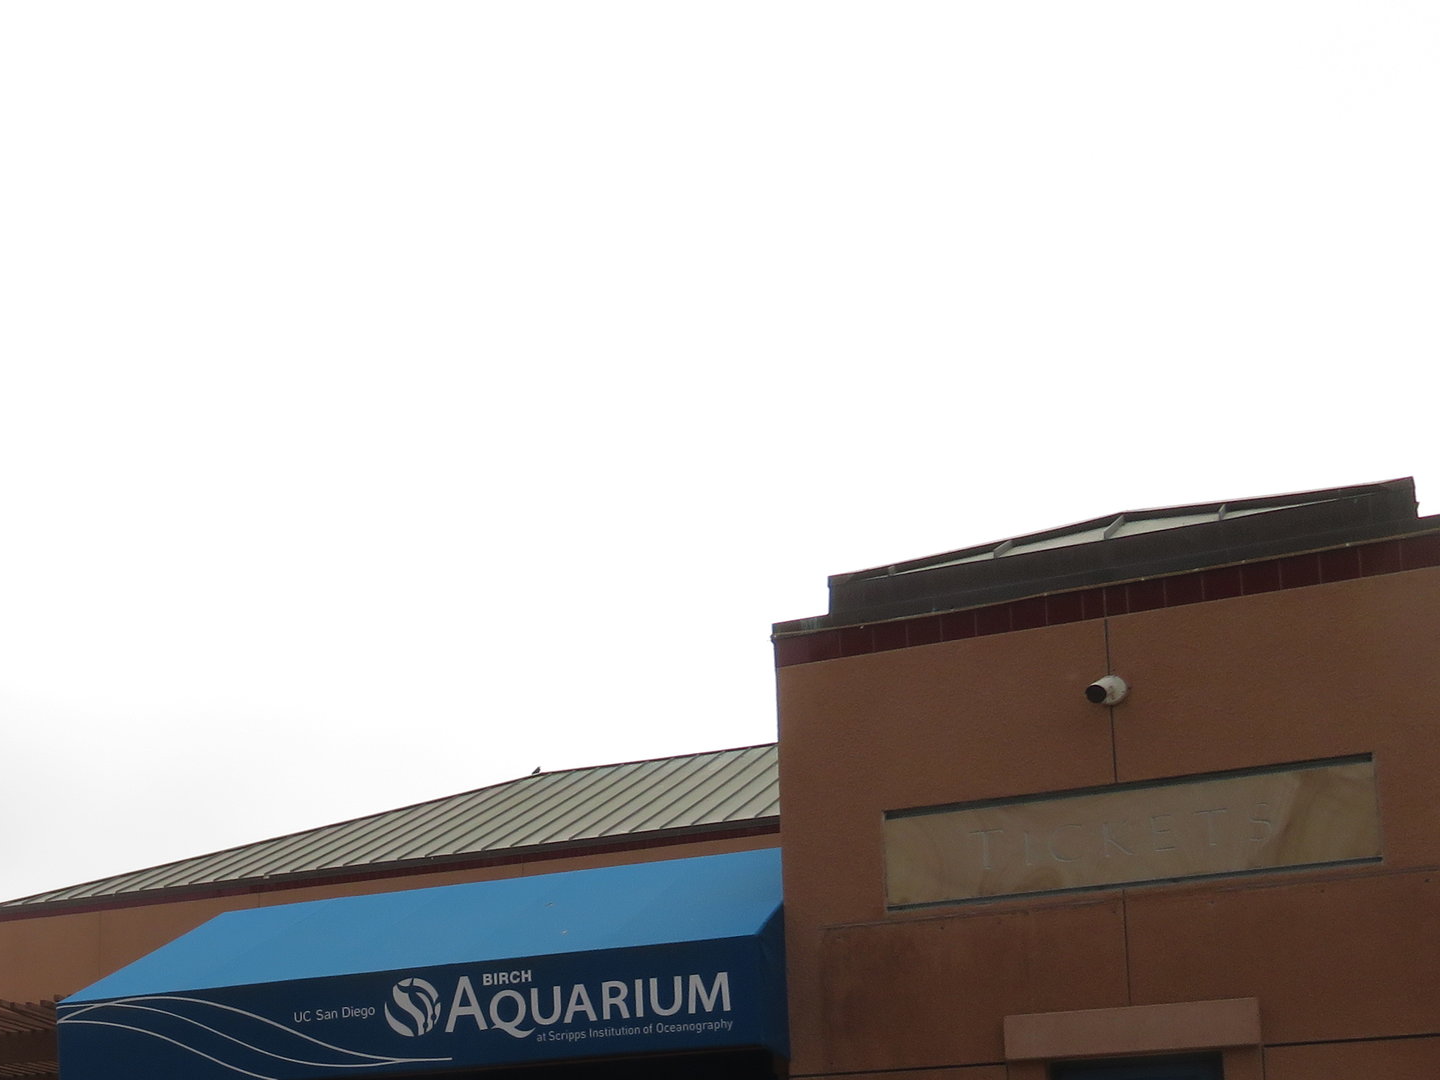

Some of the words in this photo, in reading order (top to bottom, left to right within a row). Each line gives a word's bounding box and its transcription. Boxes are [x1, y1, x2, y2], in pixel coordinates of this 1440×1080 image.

[968, 801, 1274, 870] TICKETS
[482, 970, 532, 986] BIRCH
[293, 1010, 312, 1023] UC
[315, 1008, 339, 1022] San
[341, 1006, 376, 1021] Diego
[444, 971, 732, 1039] AQUARIUM
[536, 1031, 547, 1042] at
[547, 1029, 587, 1043] Scripps
[588, 1024, 641, 1038] Institution
[642, 1023, 654, 1034] of
[655, 1018, 734, 1034] Oceanography
